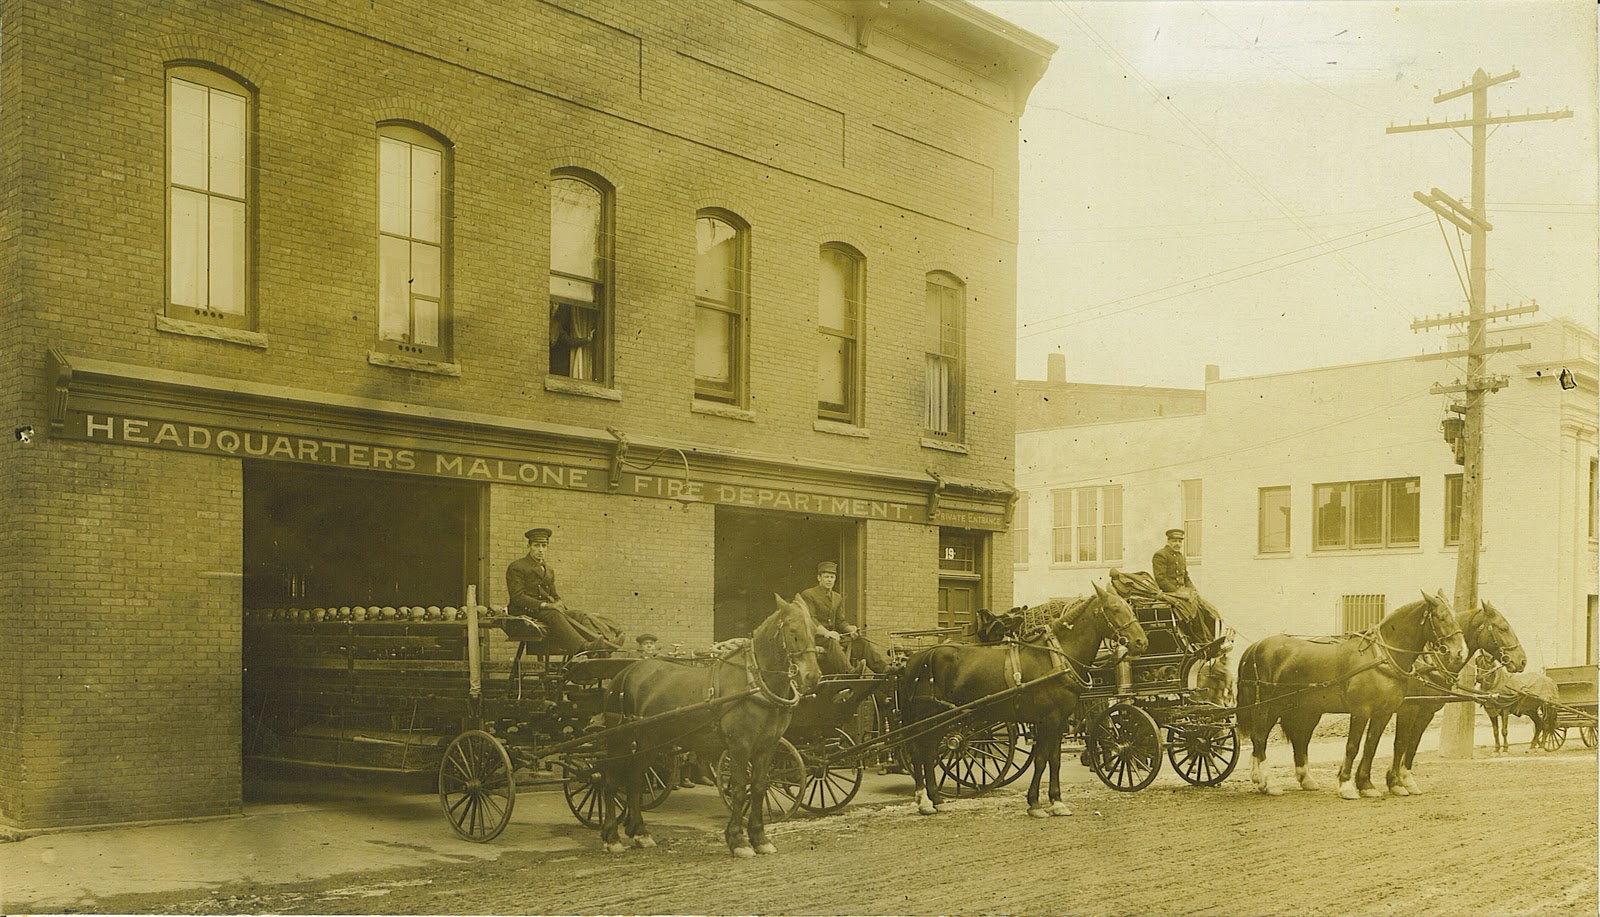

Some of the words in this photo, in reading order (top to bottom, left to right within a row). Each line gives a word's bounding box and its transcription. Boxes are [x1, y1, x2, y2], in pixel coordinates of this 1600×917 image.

[86, 414, 416, 471] HEADQUARTERS
[435, 454, 588, 488] MALONE
[634, 475, 704, 500] FIRE
[719, 484, 913, 521] DEPARTMENT.
[935, 509, 966, 523] PRIVATE
[967, 513, 1001, 526] ENTRANCE
